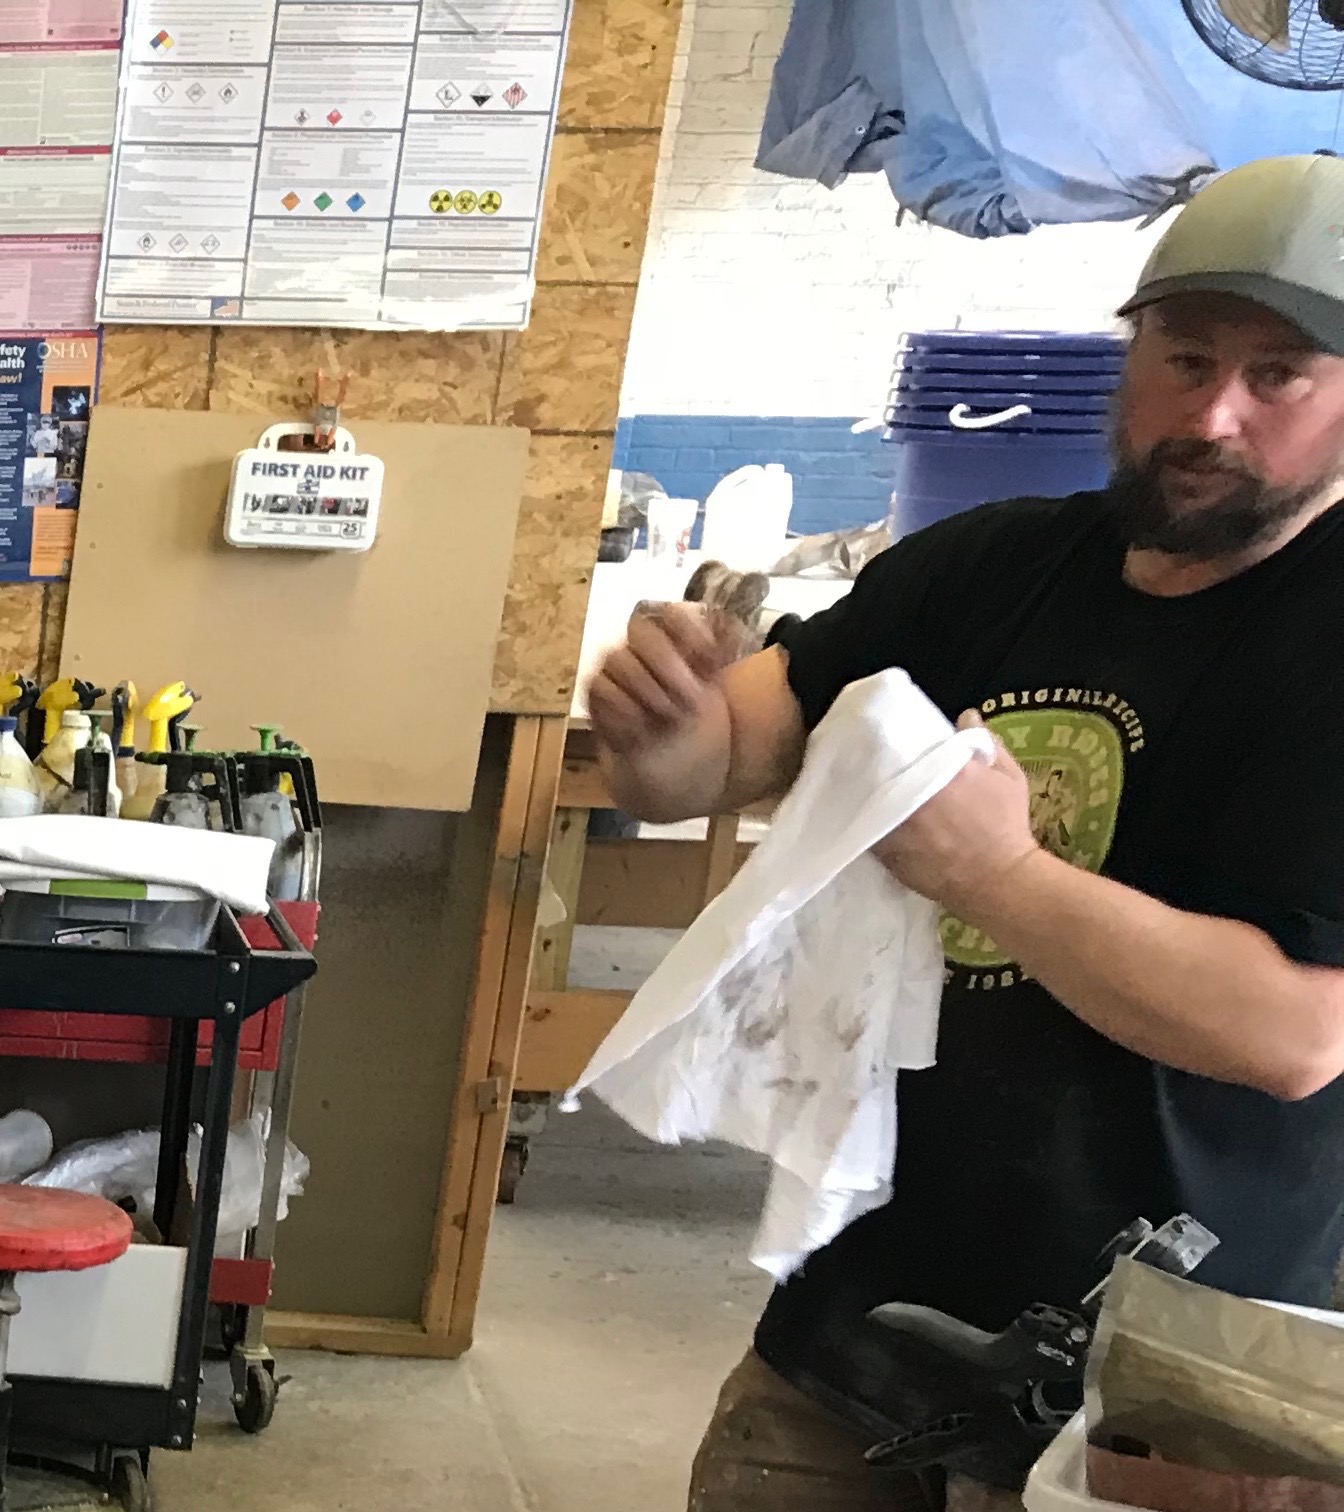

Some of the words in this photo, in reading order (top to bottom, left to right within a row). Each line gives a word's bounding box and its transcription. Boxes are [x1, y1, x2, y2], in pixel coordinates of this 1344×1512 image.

[37, 341, 88, 360] OSHA
[251, 461, 301, 478] FIRST
[304, 463, 337, 480] AID
[339, 465, 370, 481] KIT
